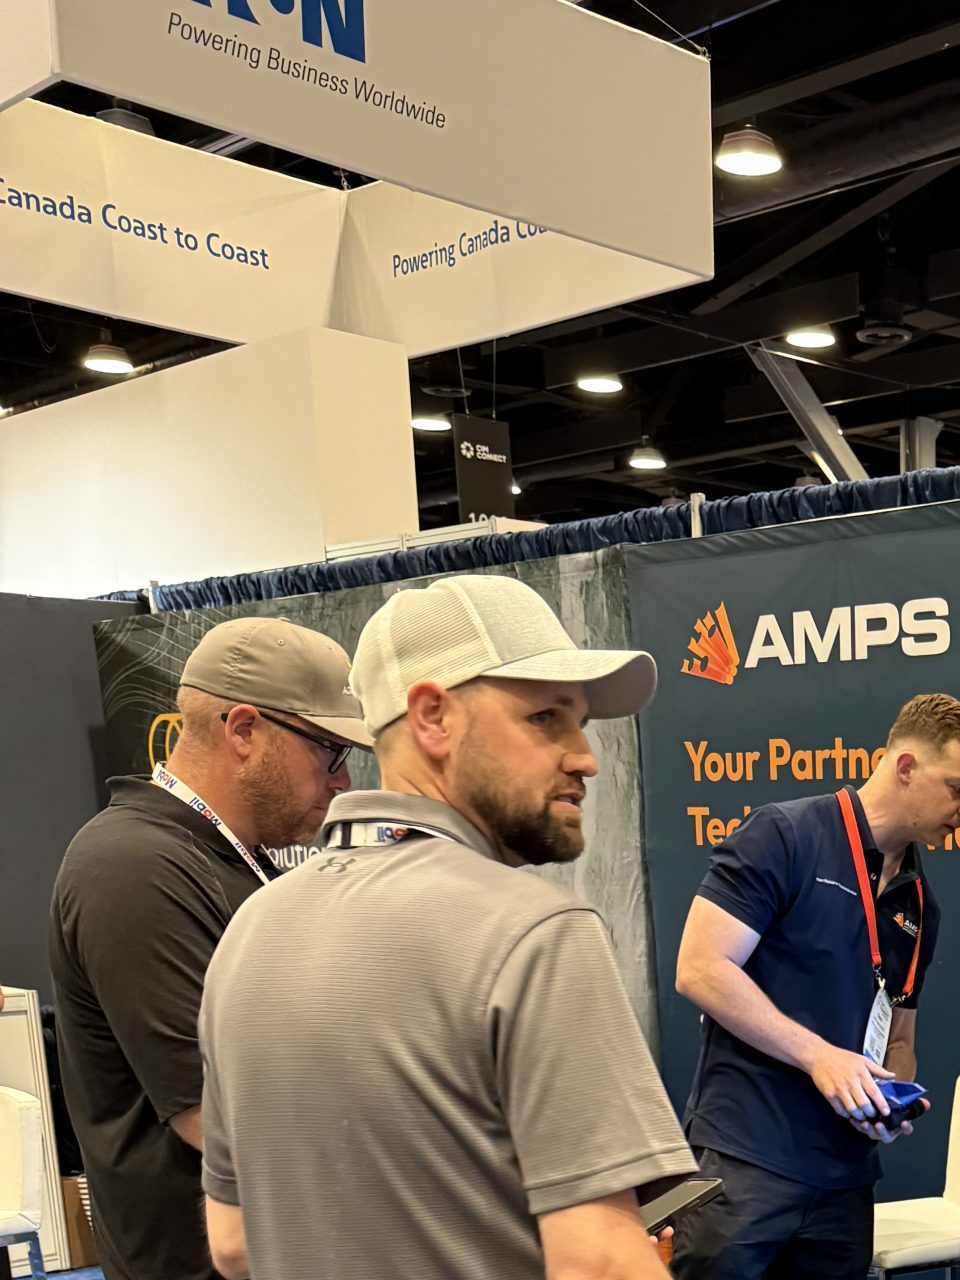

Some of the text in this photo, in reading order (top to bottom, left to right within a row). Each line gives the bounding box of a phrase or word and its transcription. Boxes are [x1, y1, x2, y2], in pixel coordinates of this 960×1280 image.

[168, 12, 261, 69] Powering
[267, 47, 348, 95] Business
[353, 77, 446, 128] Worldwide
[101, 203, 168, 244] Coast
[174, 228, 198, 251] to
[206, 233, 269, 270] Coast
[392, 242, 456, 278] Powering
[458, 220, 510, 257] Canada
[744, 597, 950, 668] AMPS
[683, 740, 760, 782] Your
[189, 796, 222, 827] Mobil
